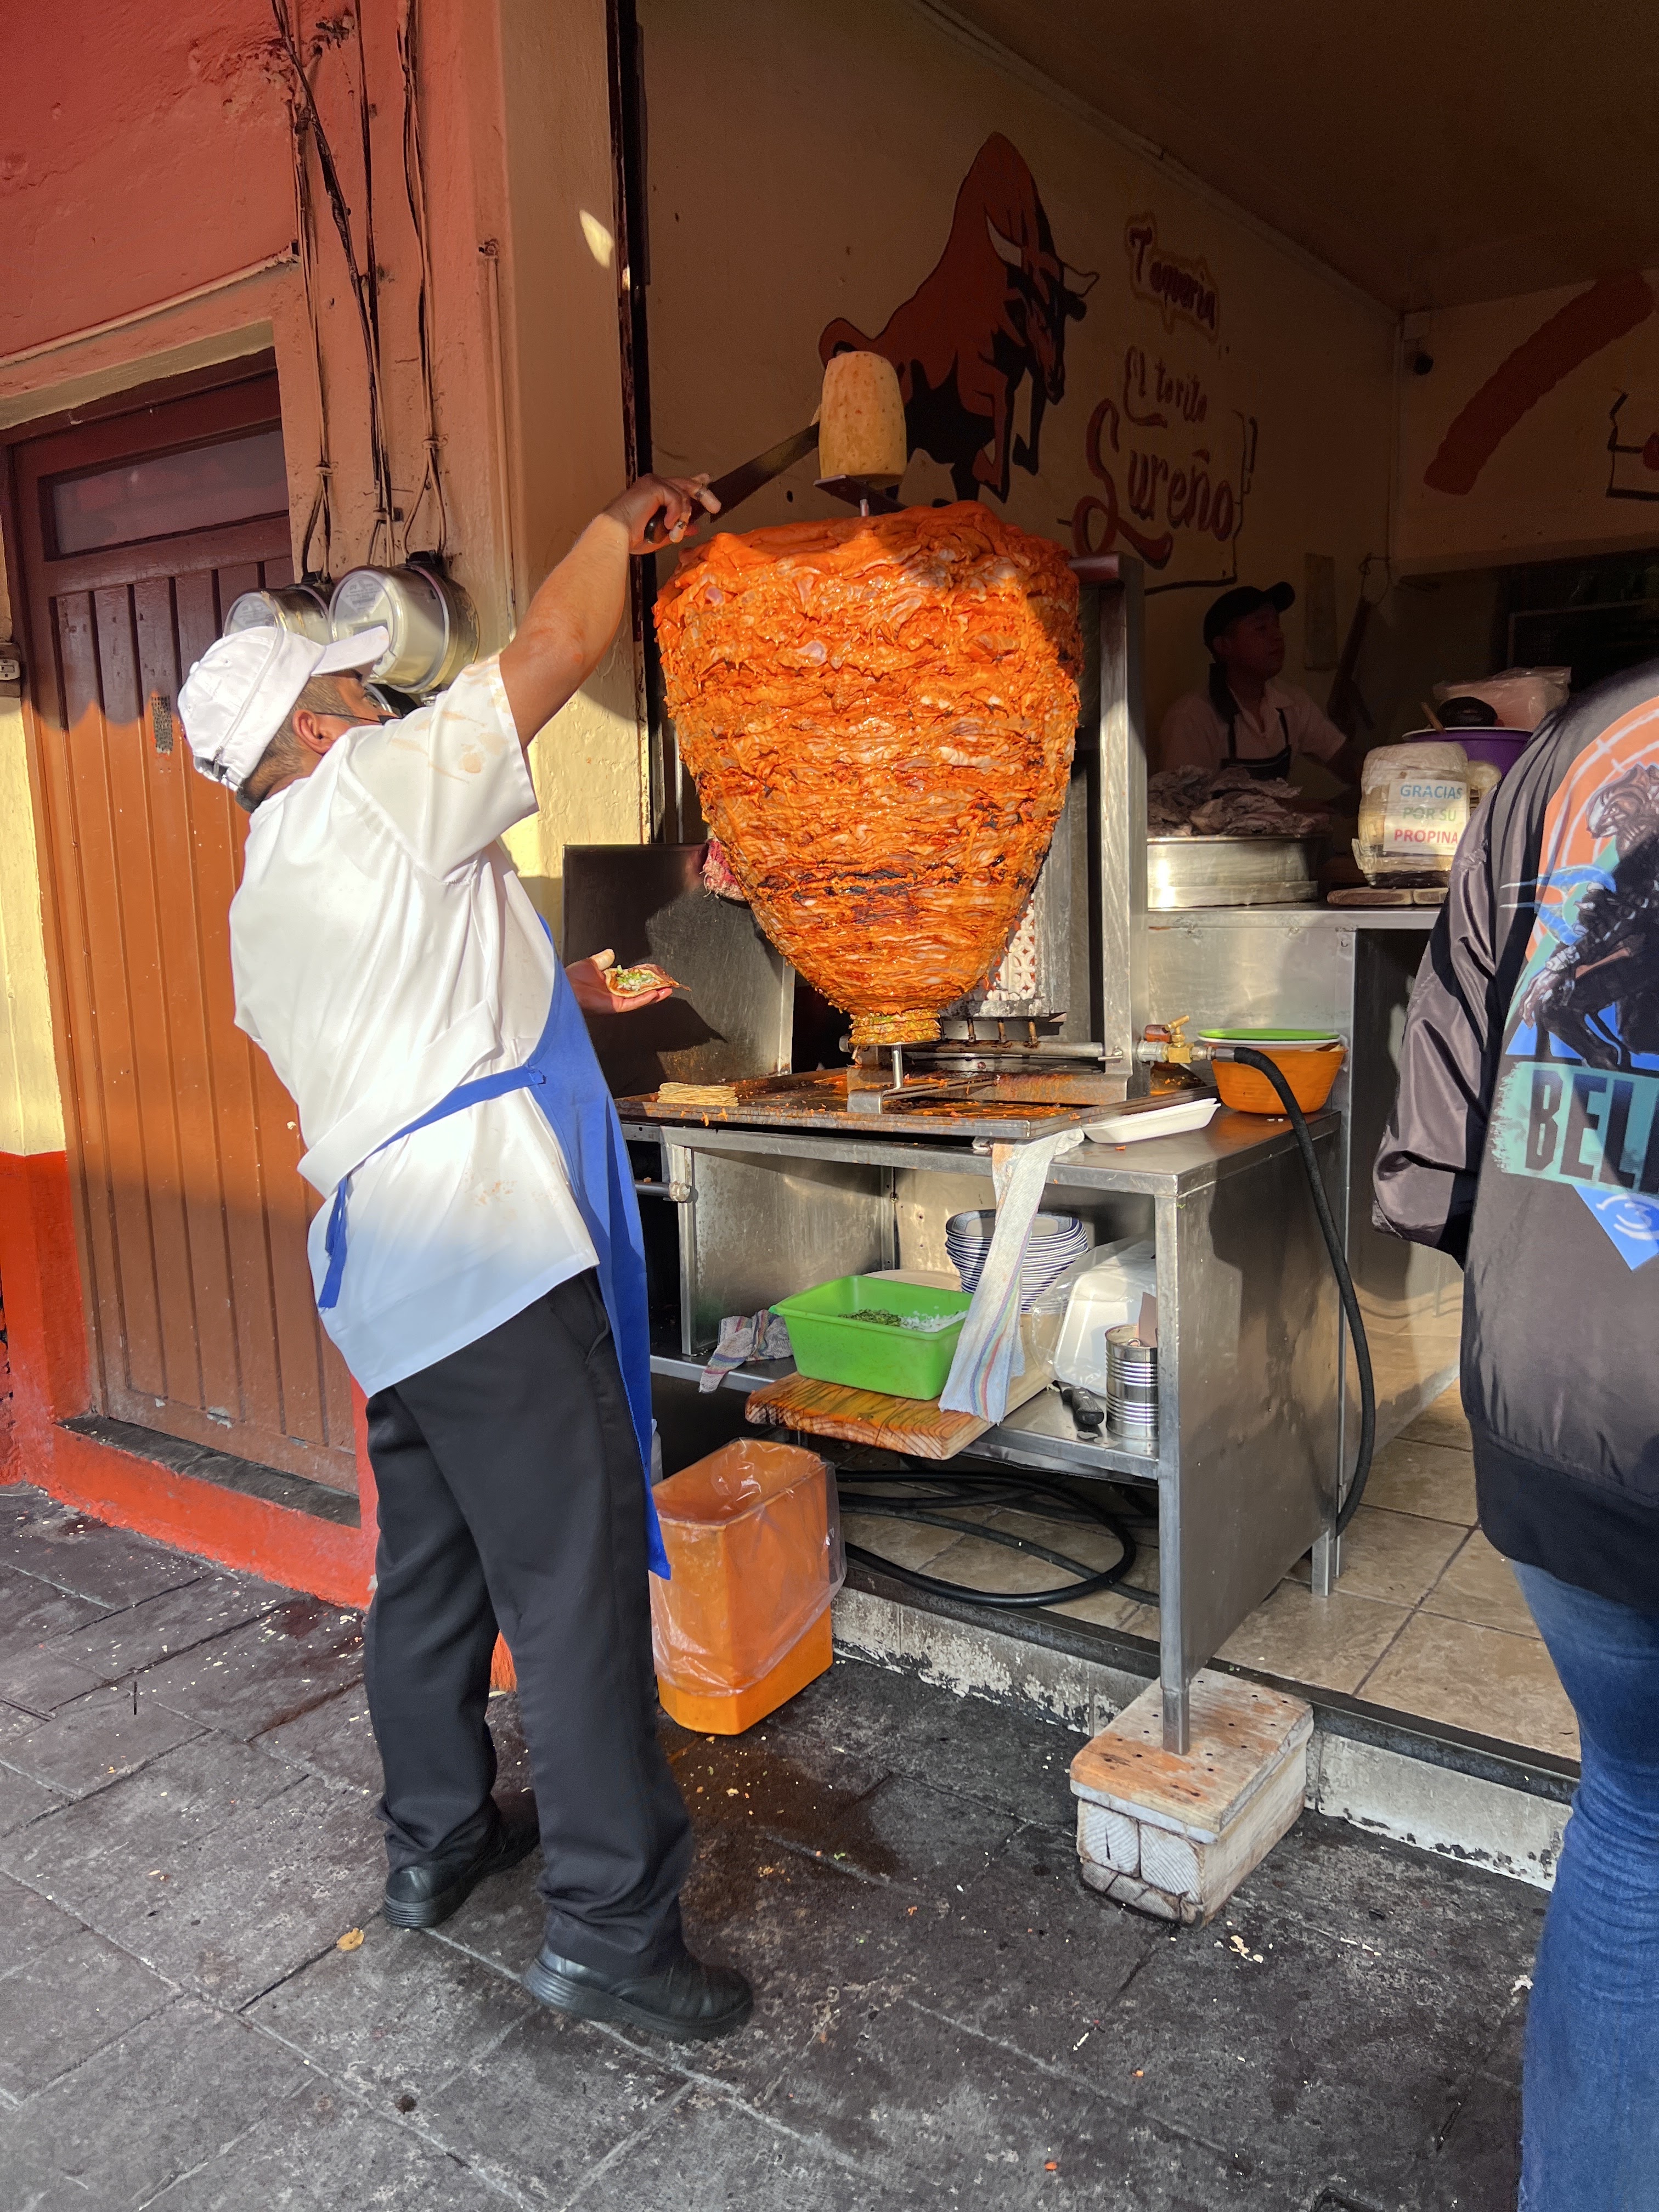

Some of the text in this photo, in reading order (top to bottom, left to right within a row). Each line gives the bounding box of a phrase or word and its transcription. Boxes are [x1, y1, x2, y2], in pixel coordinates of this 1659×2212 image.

[1072, 398, 1234, 569] Sureño
[1401, 785, 1462, 799] GRACIAS
[1403, 807, 1457, 821] POR SU
[1394, 829, 1458, 844] PROPINA
